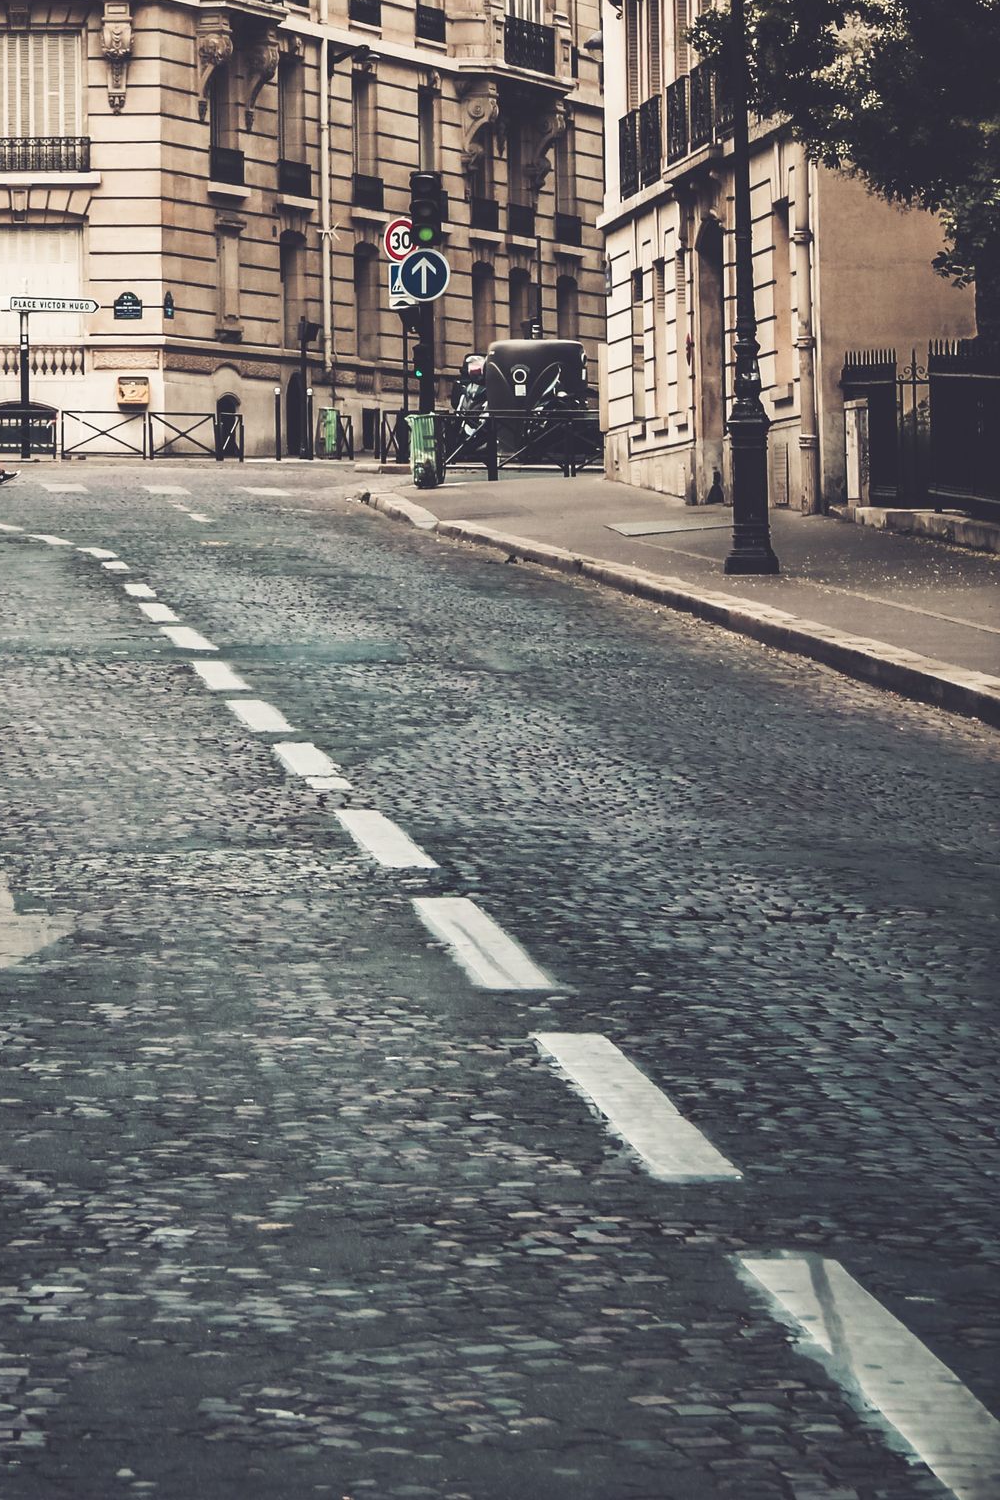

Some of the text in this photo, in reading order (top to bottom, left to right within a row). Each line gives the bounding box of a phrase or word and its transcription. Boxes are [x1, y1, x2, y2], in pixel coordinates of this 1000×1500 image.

[392, 231, 411, 250] 30
[13, 300, 90, 310] PLACE VICTOR HUGO
